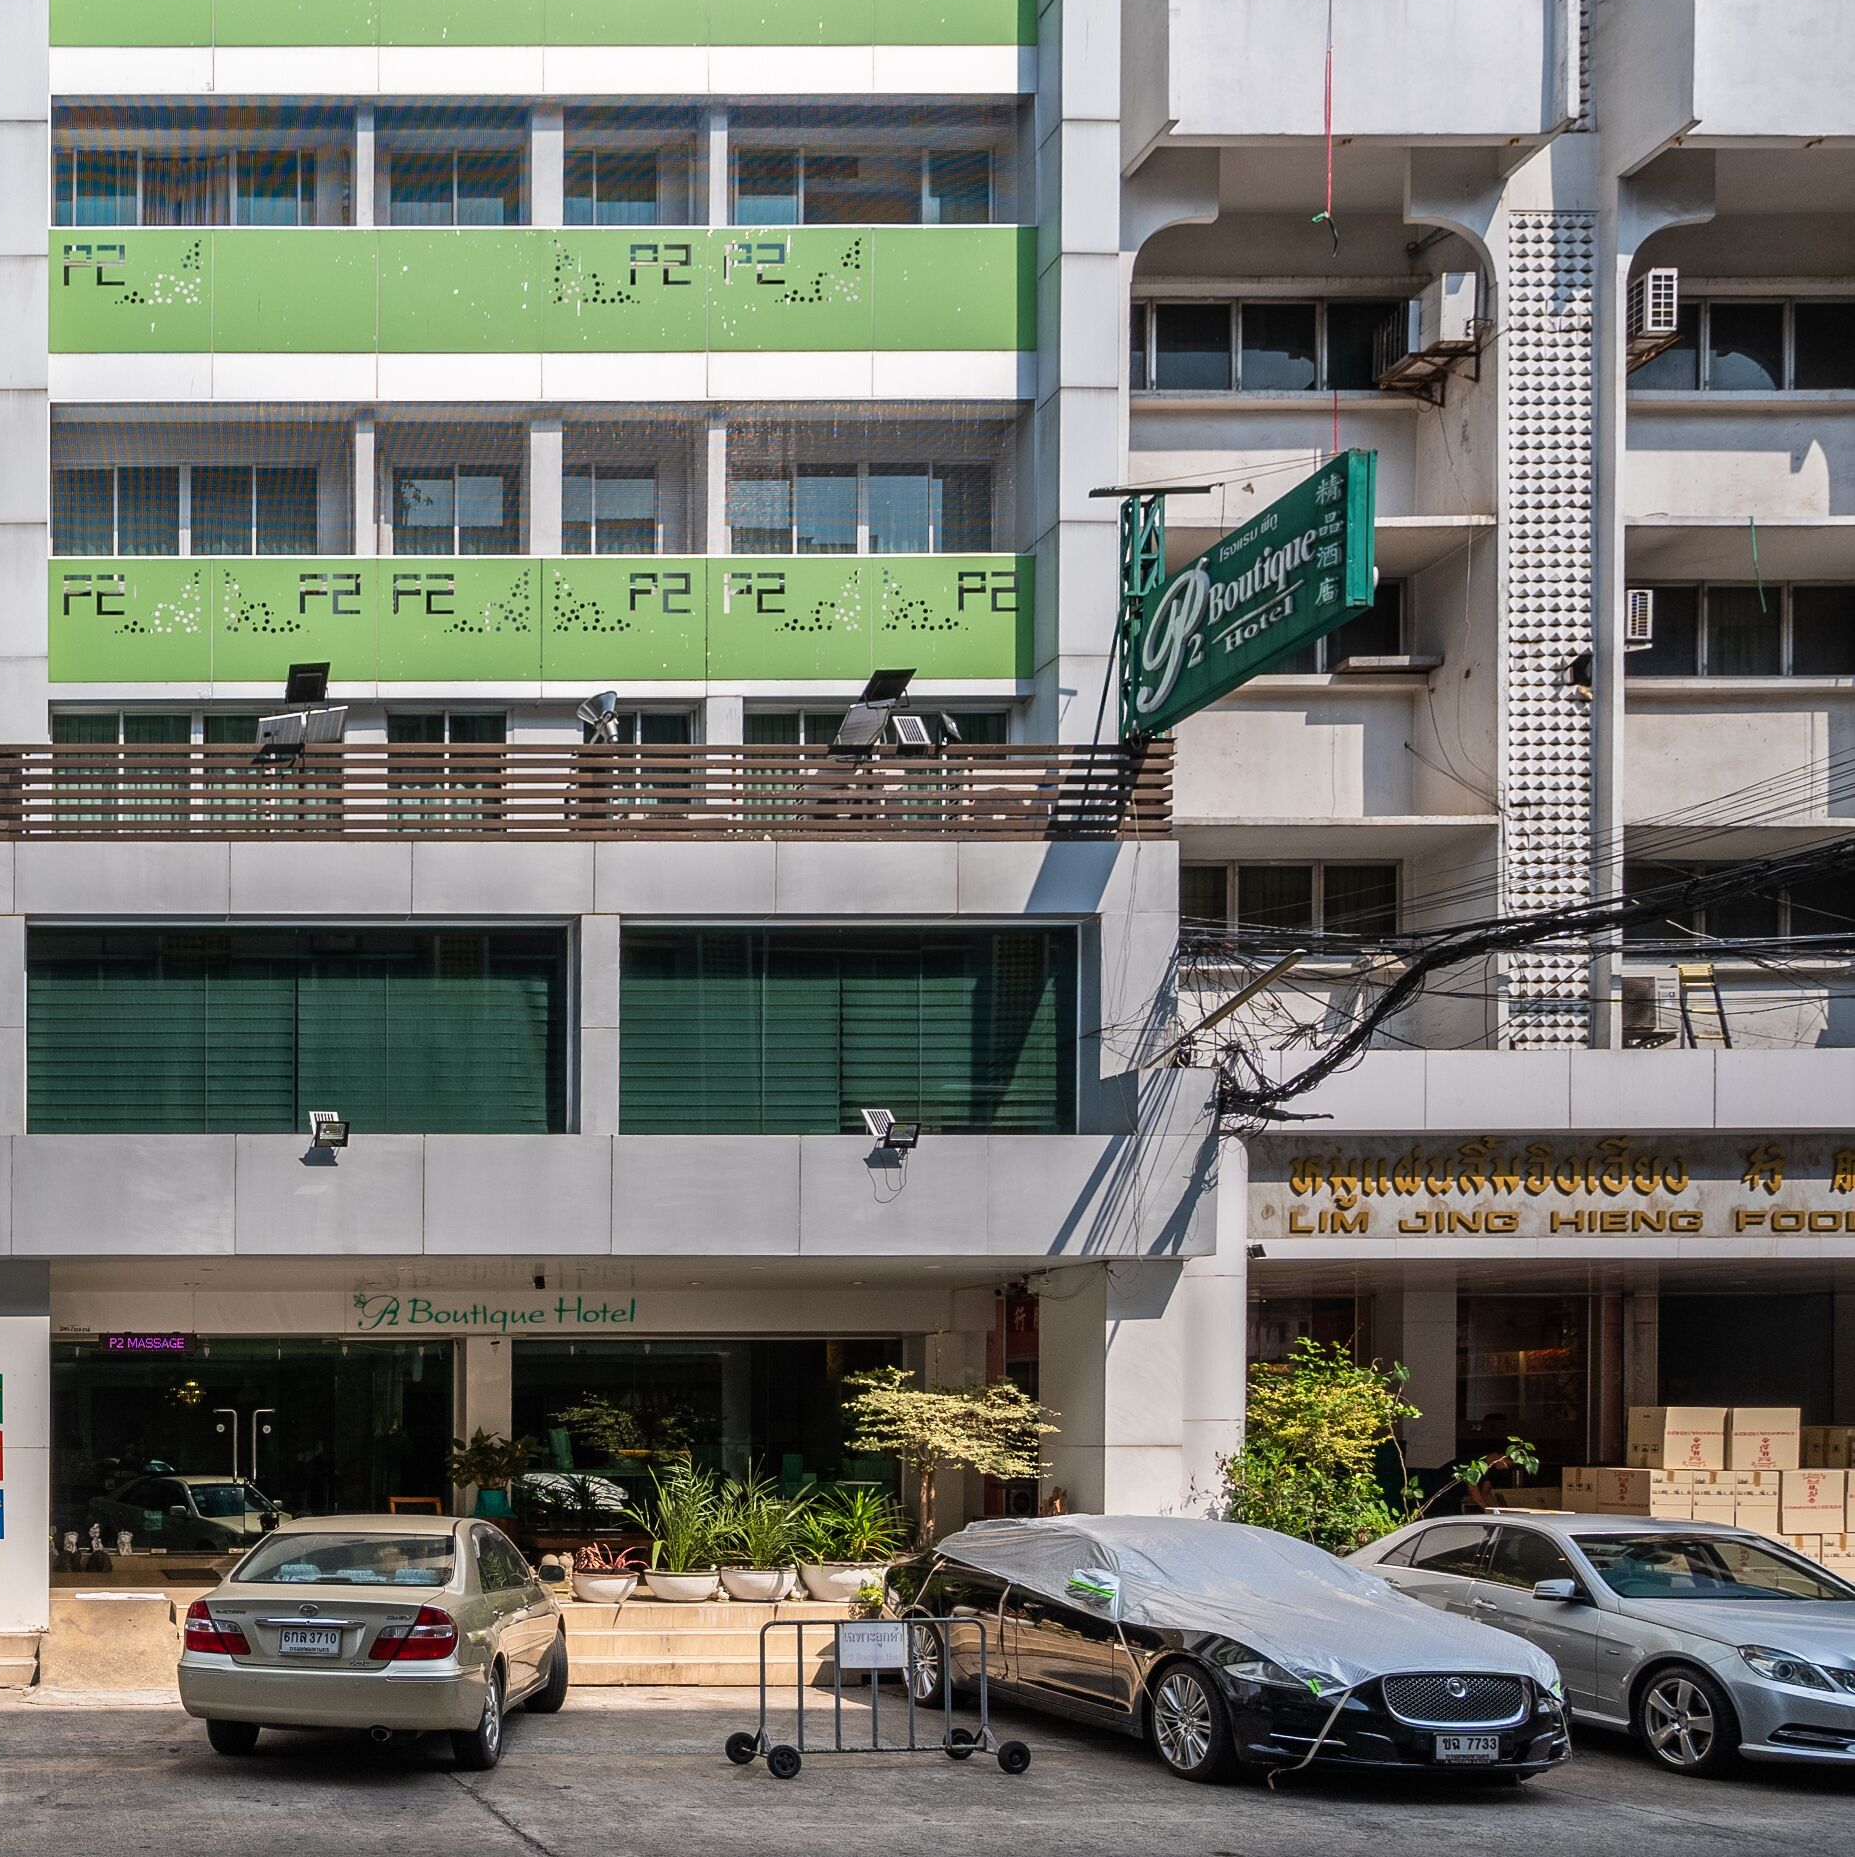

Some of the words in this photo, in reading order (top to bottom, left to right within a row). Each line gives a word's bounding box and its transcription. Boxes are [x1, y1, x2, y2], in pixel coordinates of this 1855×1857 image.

[63, 244, 125, 287] P2
[630, 244, 692, 287] P2
[723, 244, 785, 287] P2
[1315, 472, 1344, 607] 精品酒店
[63, 573, 125, 616] P2
[299, 573, 361, 616] P2
[393, 573, 455, 616] P2
[629, 573, 691, 616] P2
[722, 573, 784, 616] P2
[958, 573, 1020, 616] P2
[1208, 528, 1317, 626] Boutique
[1224, 594, 1293, 654] Hotel
[1289, 1210, 1369, 1234] LIM
[1398, 1210, 1520, 1234] JING
[1550, 1209, 1704, 1233] HIENG
[407, 1298, 546, 1333] Boutique
[553, 1296, 635, 1323] Hotel
[109, 1337, 124, 1349] P2
[127, 1337, 185, 1349] MASSAGE
[309, 1632, 337, 1644] 3710
[1467, 1738, 1497, 1750] 7733
